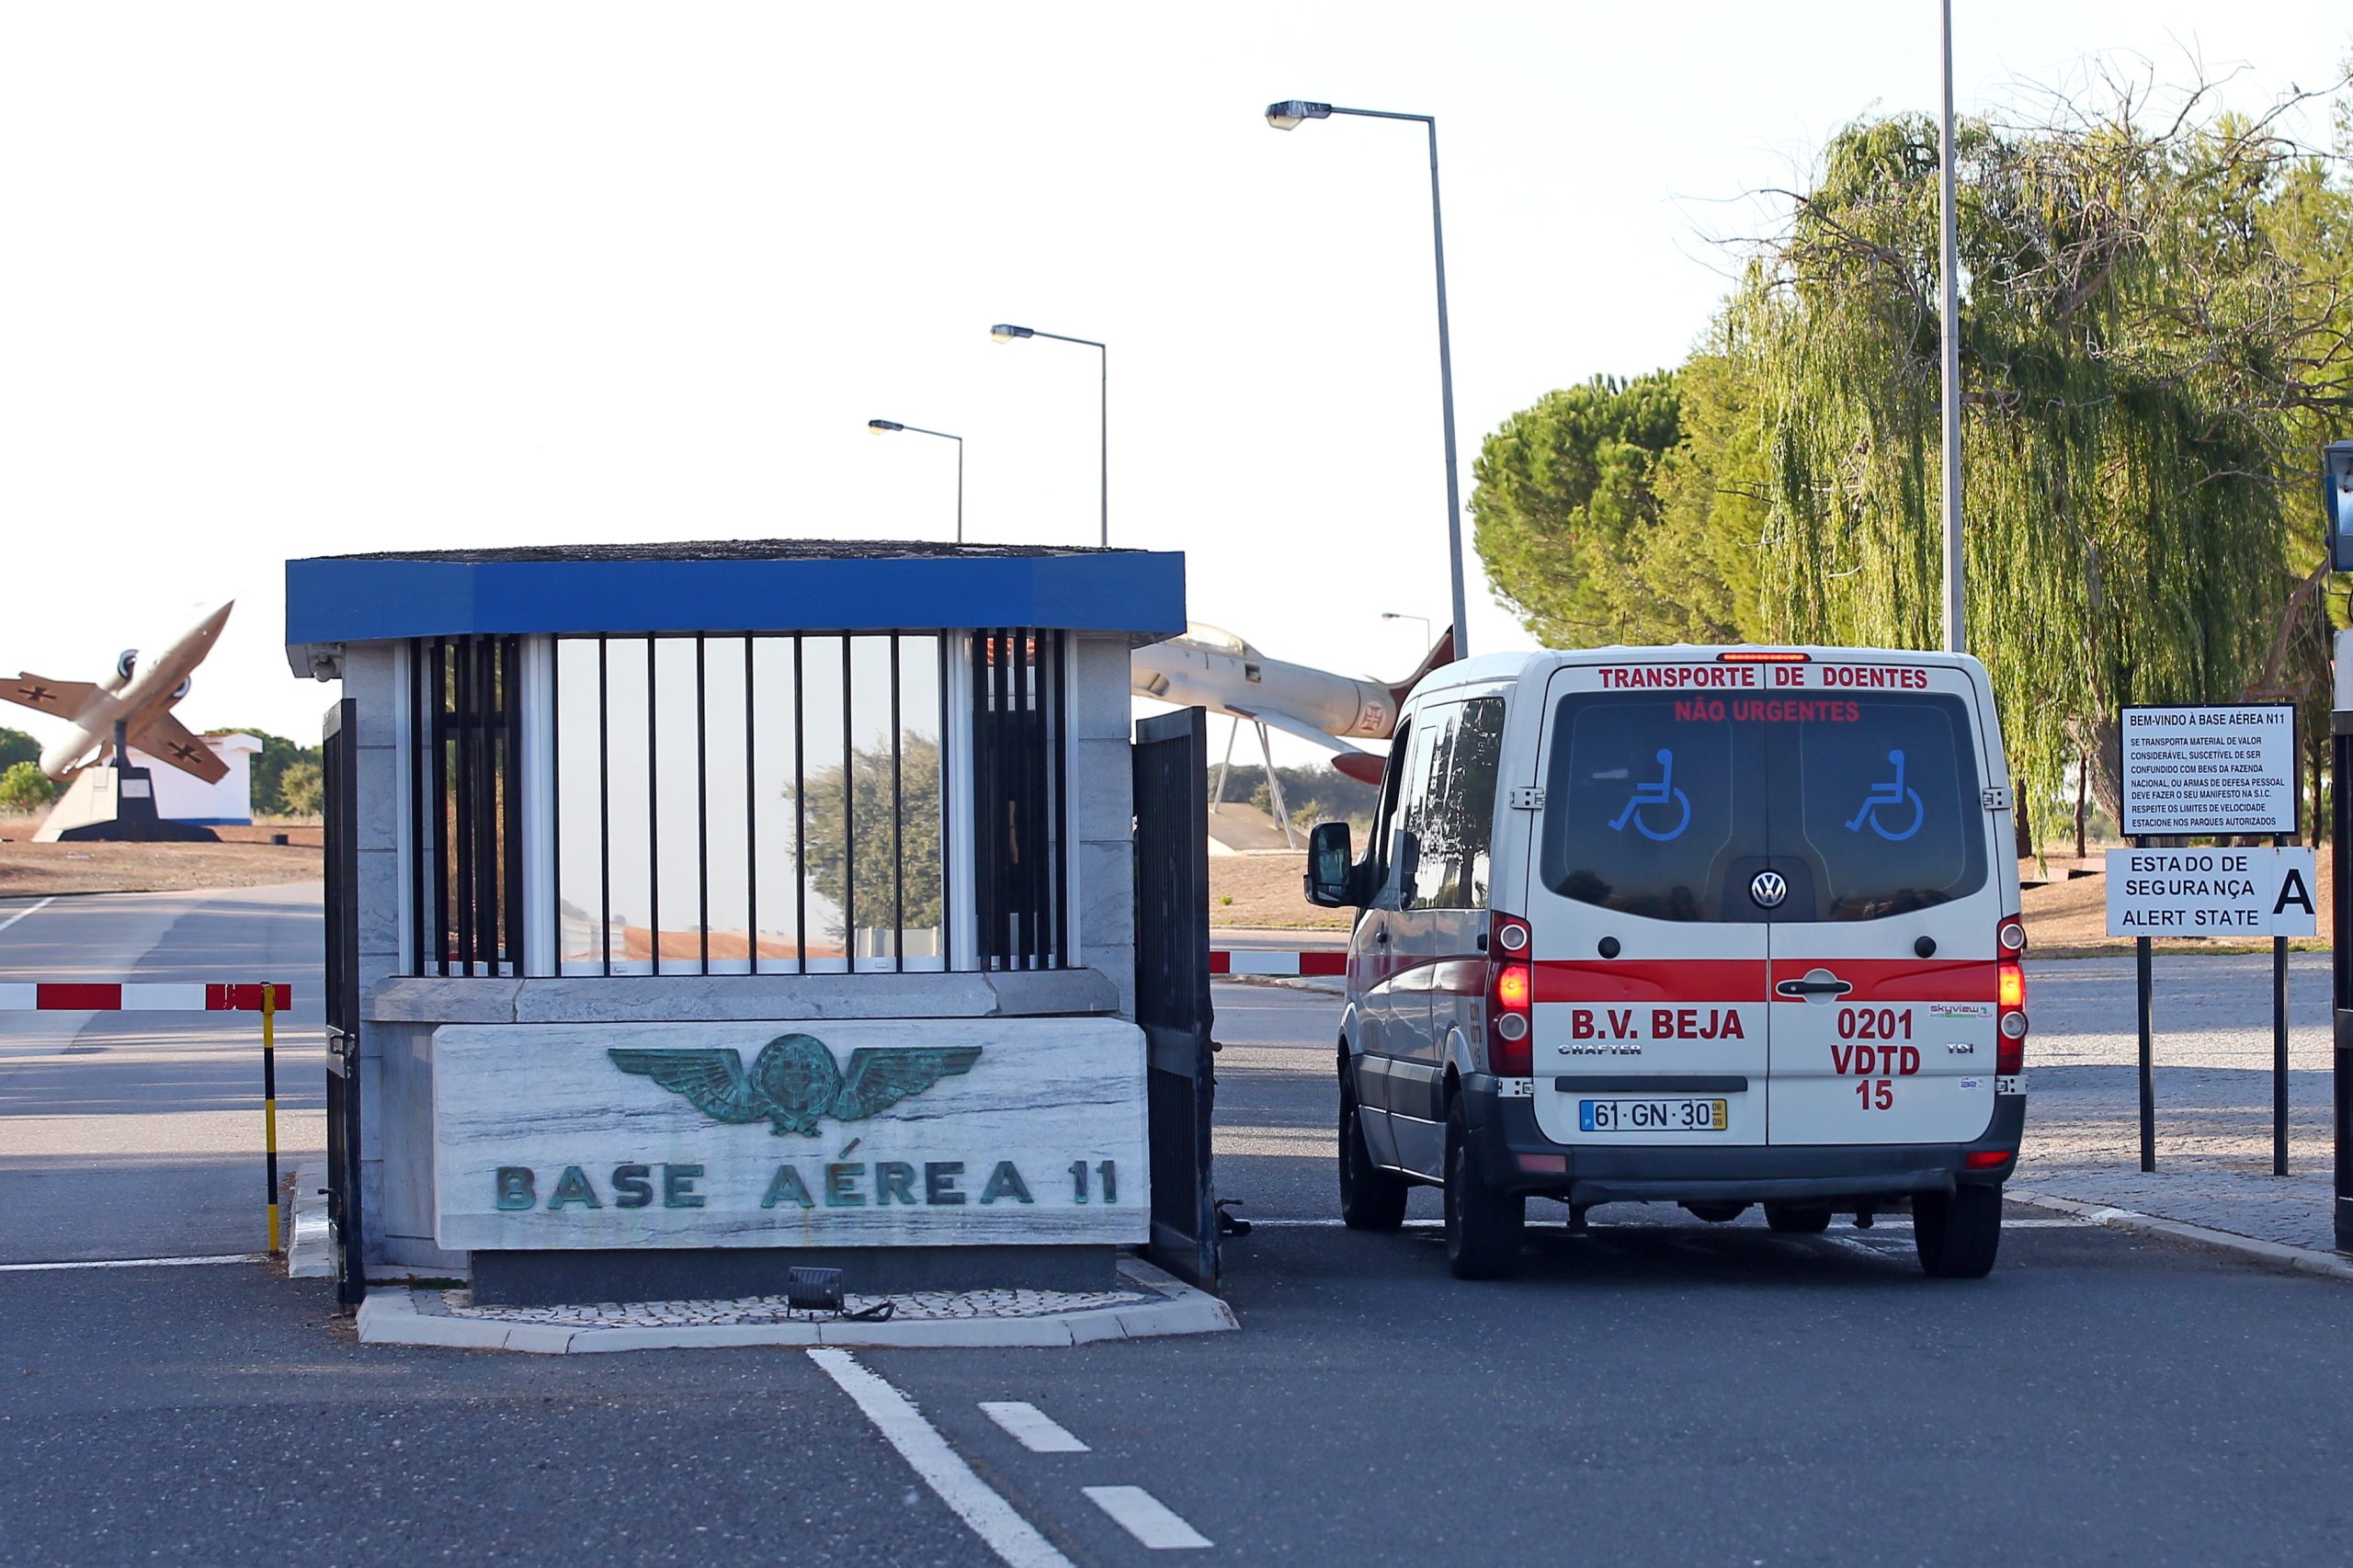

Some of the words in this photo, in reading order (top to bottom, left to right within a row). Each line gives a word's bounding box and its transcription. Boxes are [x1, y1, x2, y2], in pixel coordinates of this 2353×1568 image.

[1598, 666, 1755, 688] TRANSPORTE
[1775, 666, 1804, 687] DE
[1823, 666, 1927, 689] DOENTES
[1675, 696, 1726, 722] NÃO
[1733, 699, 1860, 722] URGENTES
[2130, 714, 2187, 726] BEM-VINDO
[2188, 711, 2197, 725] À
[2199, 713, 2226, 725] BASE
[2228, 711, 2264, 725] AÉREA
[2266, 713, 2285, 724] N11
[2130, 738, 2140, 746] SE
[2141, 737, 2188, 746] TRANSPORTA
[2189, 736, 2225, 745] MATERIAL
[2227, 736, 2236, 745] DE
[2237, 736, 2262, 745] VALOR
[2131, 750, 2188, 760] CONSIDERÁVEL,
[2188, 749, 2234, 759] SUSCETÍVEL
[2234, 751, 2245, 759] DE
[2245, 750, 2261, 759] SER
[2131, 766, 2178, 774] CONFUNDIDO
[2179, 765, 2196, 773] COM
[2198, 765, 2218, 773] BENS
[2219, 765, 2229, 773] DA
[2230, 764, 2263, 773] FAZENDA
[2131, 779, 2170, 788] NACIONAL,
[2171, 779, 2182, 788] OU
[2183, 778, 2209, 787] ARMAS
[2211, 778, 2221, 787] DE
[2222, 778, 2250, 787] DEFESA
[2252, 778, 2285, 787] PESSOAL
[2131, 791, 2151, 800] DEVE
[2152, 791, 2175, 800] FAZER
[2176, 790, 2182, 799] O
[2183, 790, 2199, 799] SEU
[2200, 790, 2241, 799] MANIFESTO
[2242, 790, 2253, 798] NA
[2131, 805, 2166, 813] RESPEITE
[2167, 804, 2178, 812] OS
[2179, 804, 2207, 812] LIMITES
[2209, 804, 2219, 812] DE
[2220, 803, 2266, 812] VELOCIDADE
[2131, 819, 2172, 827] ESTACIONE
[2173, 818, 2189, 826] NOS
[2190, 818, 2224, 826] PARQUES
[2225, 817, 2276, 826] AUTORIZADOS
[2131, 856, 2213, 872] ESTADO
[2222, 856, 2247, 871] DE
[2126, 880, 2255, 900] SEGURANÇA
[2272, 869, 2315, 915] A
[2122, 910, 2186, 926] ALERT
[2195, 910, 2258, 926] STATE
[1572, 1009, 1638, 1040] B.V.
[1652, 1009, 1745, 1040] BEJA
[1837, 1008, 1912, 1040] 0201
[1558, 1044, 1642, 1055] CRAFTER
[1947, 1043, 1973, 1054] TDI
[1830, 1045, 1920, 1075] VDTD
[1856, 1079, 1893, 1110] 15
[496, 1164, 705, 1210] BASE
[760, 1137, 1035, 1209] AÉREA
[1068, 1160, 1117, 1204] 11
